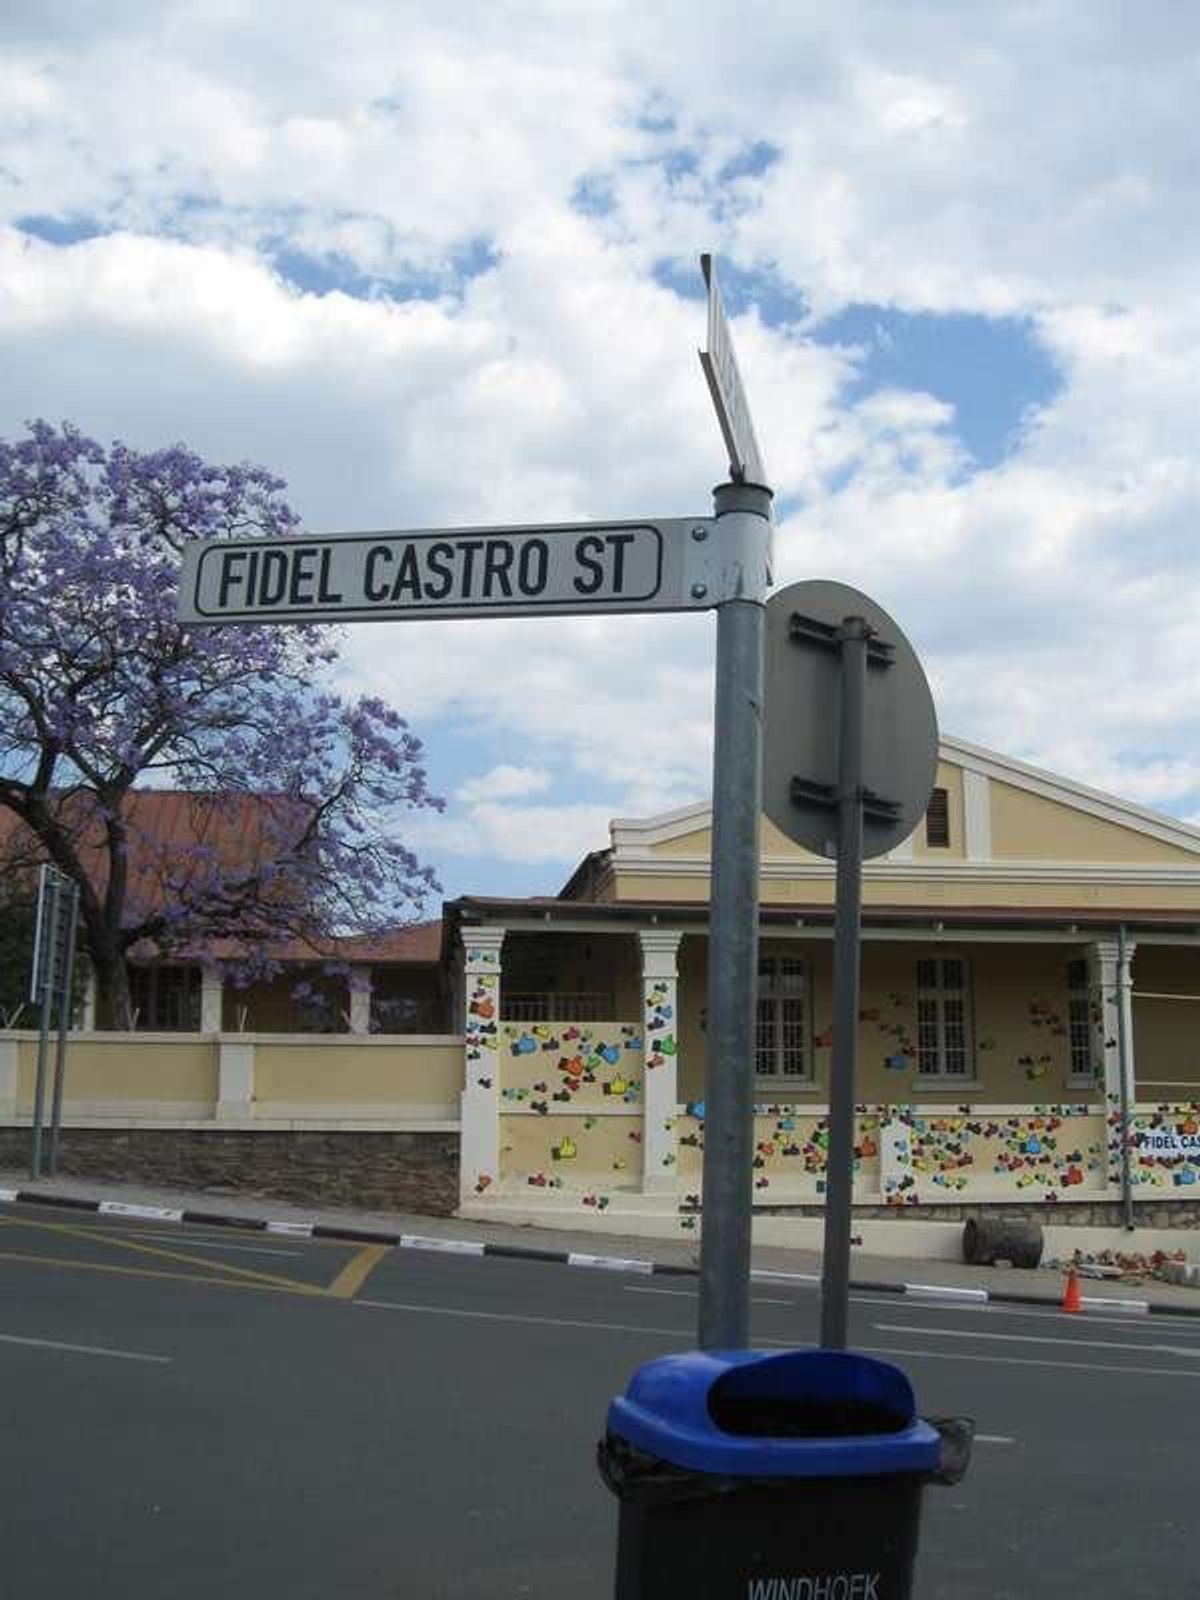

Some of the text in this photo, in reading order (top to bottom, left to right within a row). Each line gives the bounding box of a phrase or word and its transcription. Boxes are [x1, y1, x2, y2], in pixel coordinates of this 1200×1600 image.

[218, 533, 635, 608] FIDEL CASTRO ST
[1143, 1135, 1178, 1149] FIDEL
[748, 1573, 881, 1600] WINDHOEK
